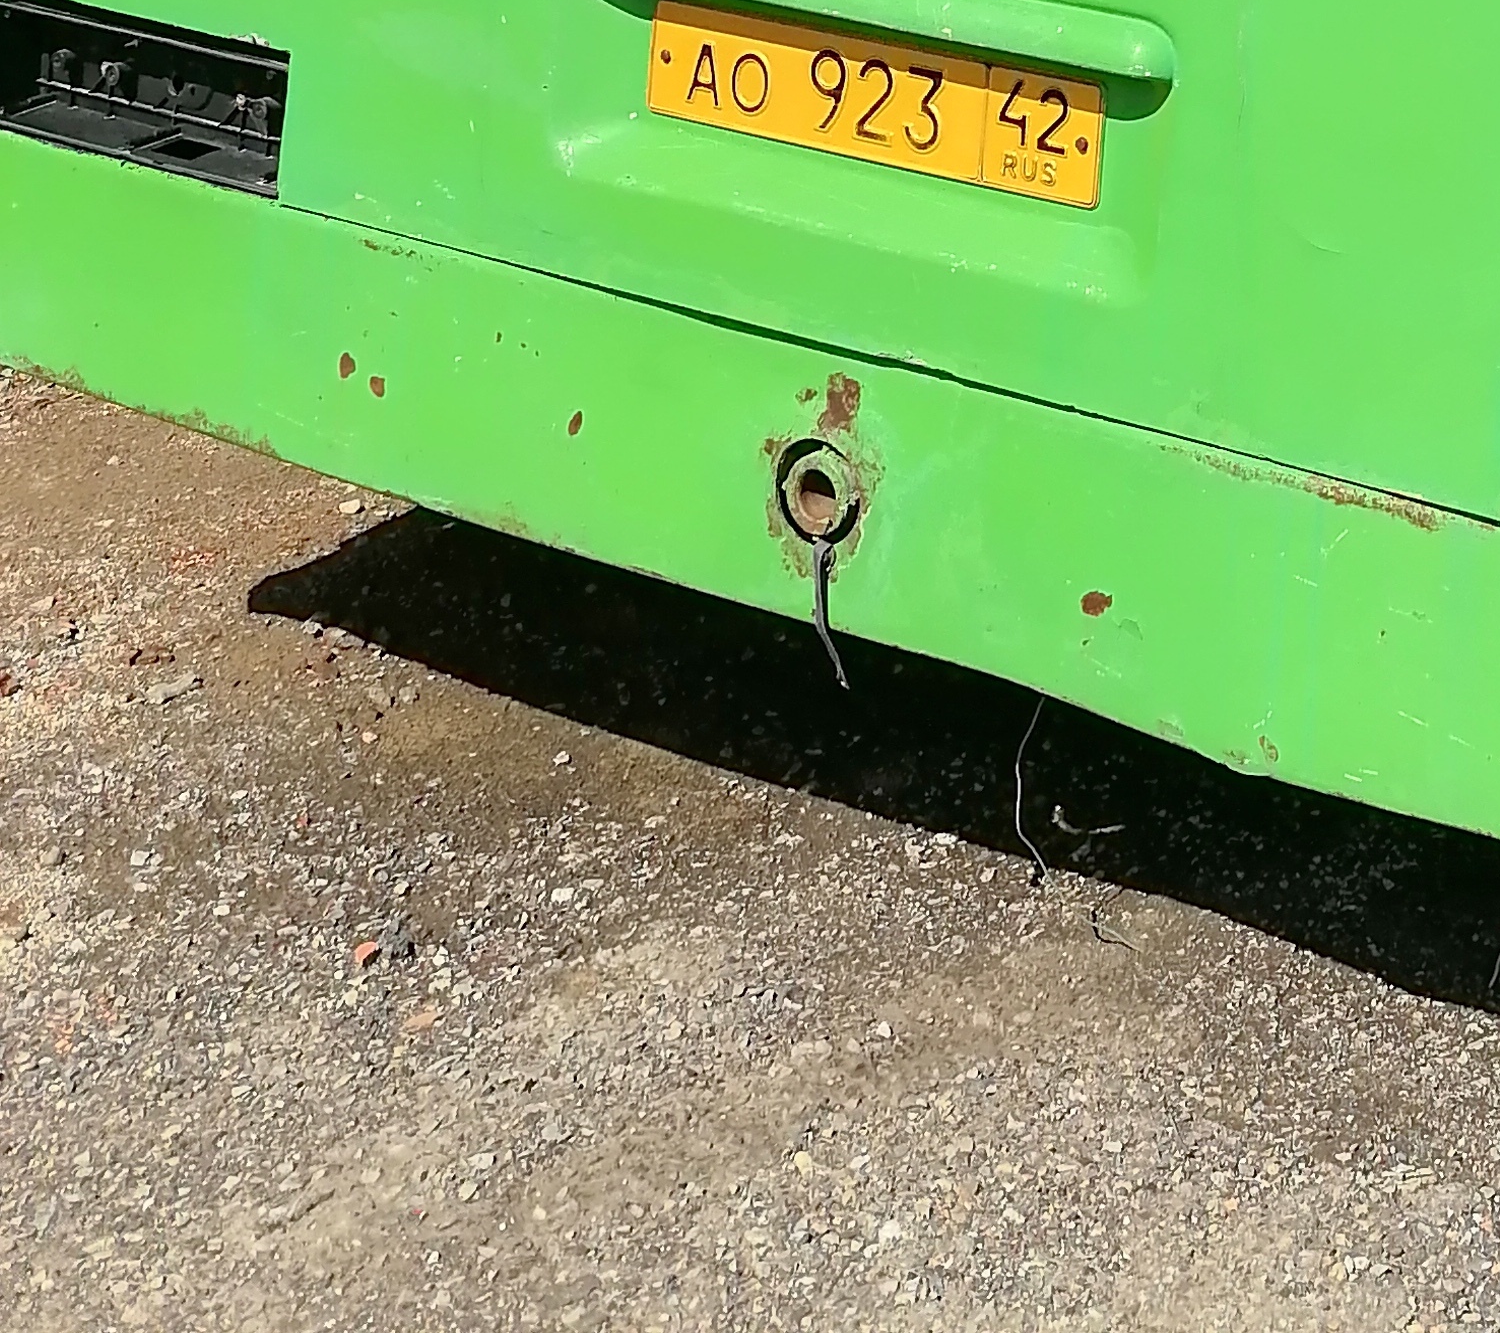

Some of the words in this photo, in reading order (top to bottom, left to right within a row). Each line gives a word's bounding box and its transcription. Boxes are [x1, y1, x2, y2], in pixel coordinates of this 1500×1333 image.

[810, 48, 944, 151] 923
[998, 79, 1068, 156] 42
[1001, 152, 1057, 186] RUS
